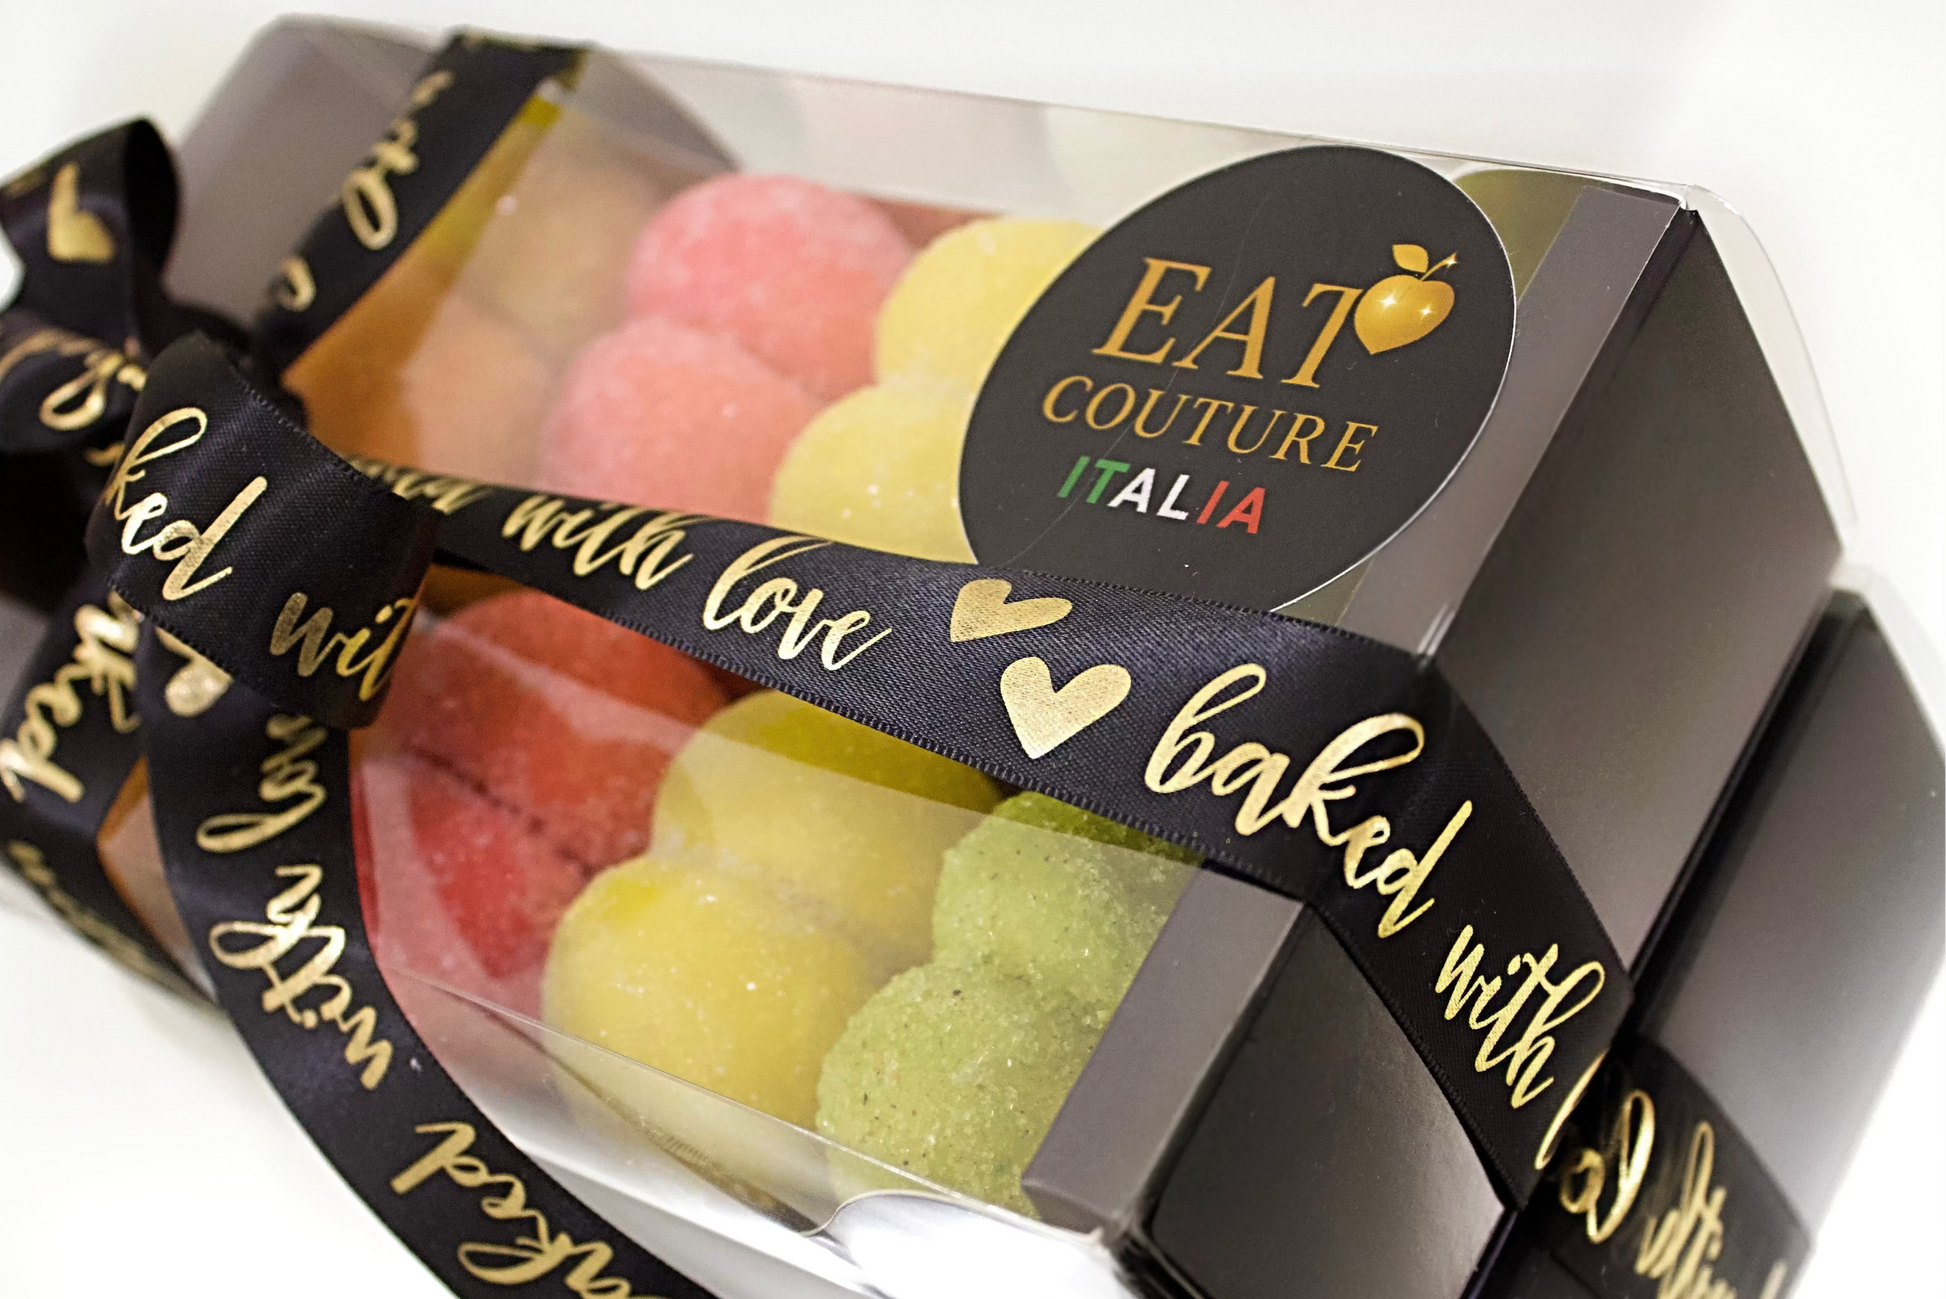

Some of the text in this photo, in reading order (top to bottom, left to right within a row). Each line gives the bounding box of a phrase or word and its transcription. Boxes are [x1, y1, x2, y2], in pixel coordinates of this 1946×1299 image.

[1092, 256, 1364, 389] EAT
[1041, 376, 1379, 473] COUTURE
[1057, 456, 1266, 534] ITALIA
[104, 407, 417, 702] ked wit
[501, 494, 892, 671] with love
[1144, 663, 1605, 1109] baked with
[208, 865, 393, 1090] with
[390, 1121, 634, 1299] aked
